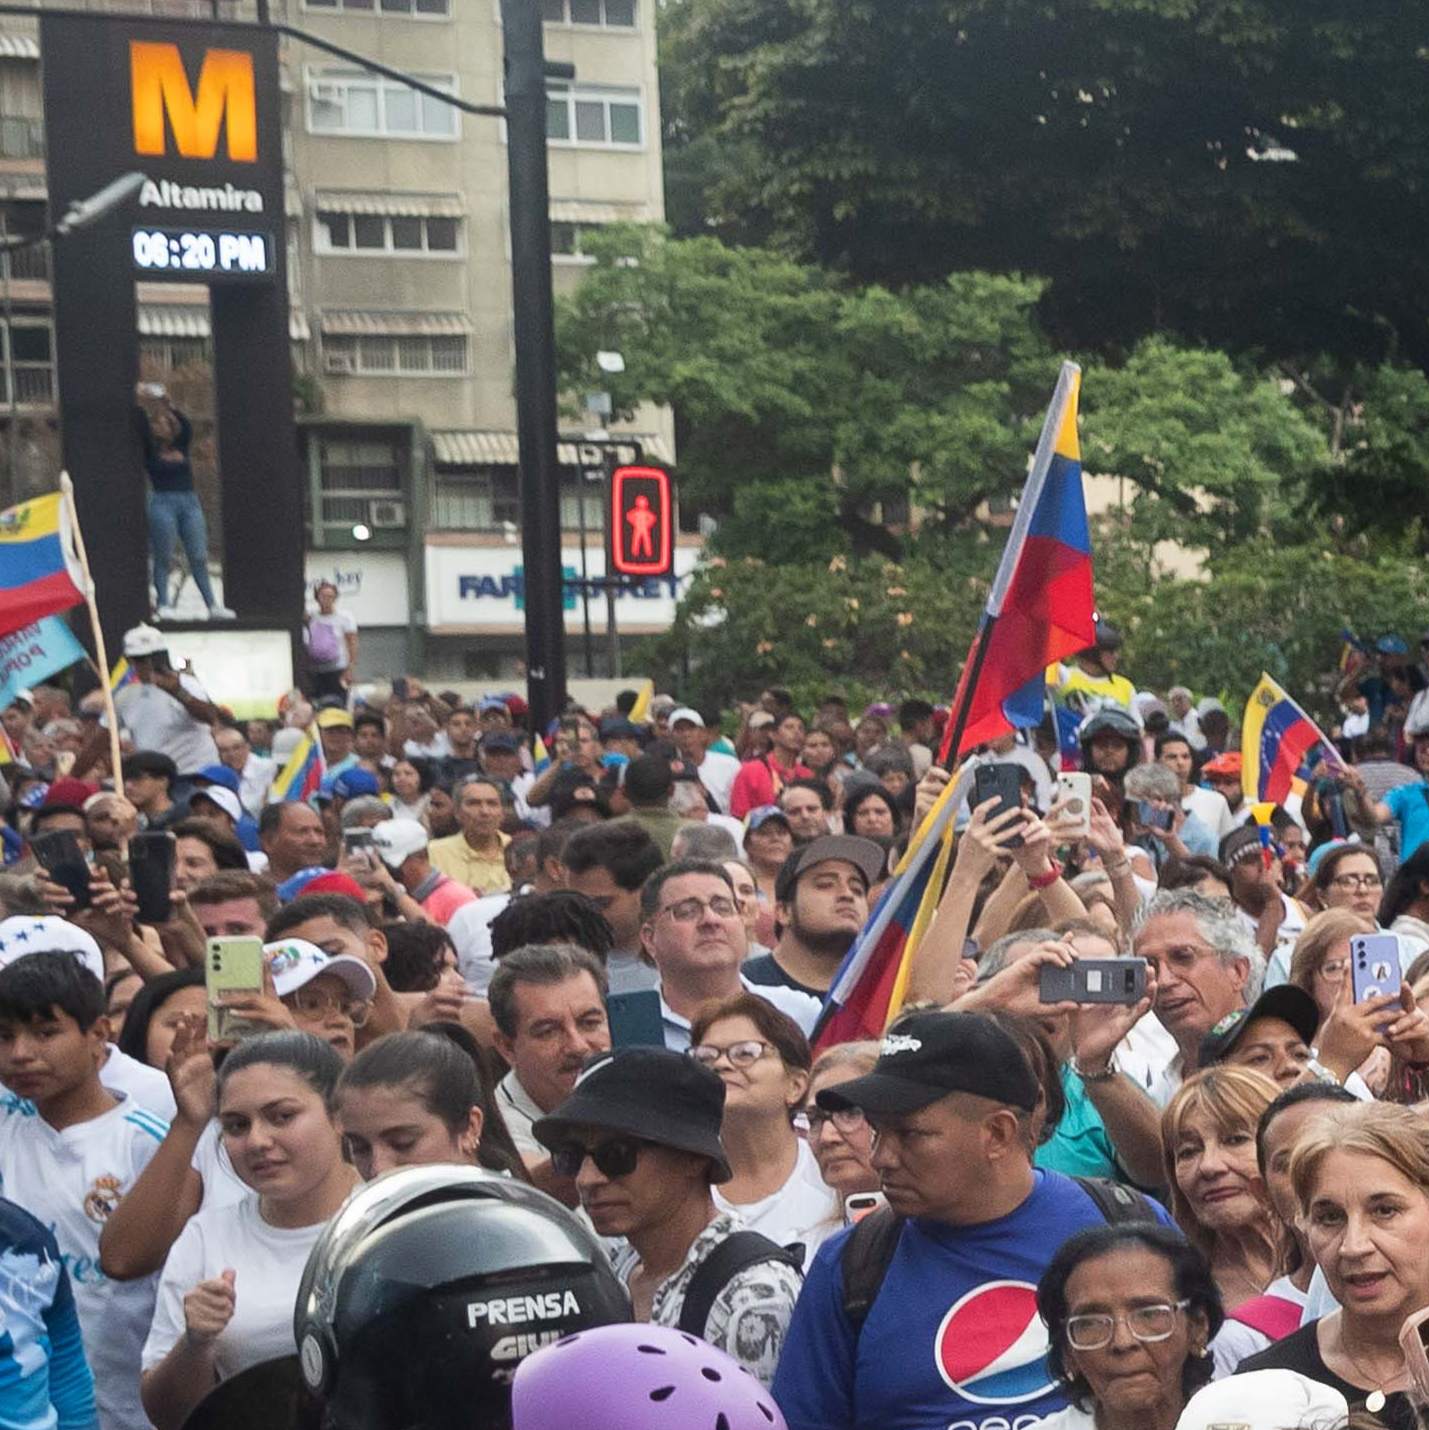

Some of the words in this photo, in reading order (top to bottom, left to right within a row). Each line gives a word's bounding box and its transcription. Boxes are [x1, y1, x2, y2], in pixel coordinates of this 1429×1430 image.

[129, 39, 258, 163] M
[139, 179, 264, 212] Altamira
[219, 234, 266, 271] PM
[467, 1290, 581, 1328] PRENSA
